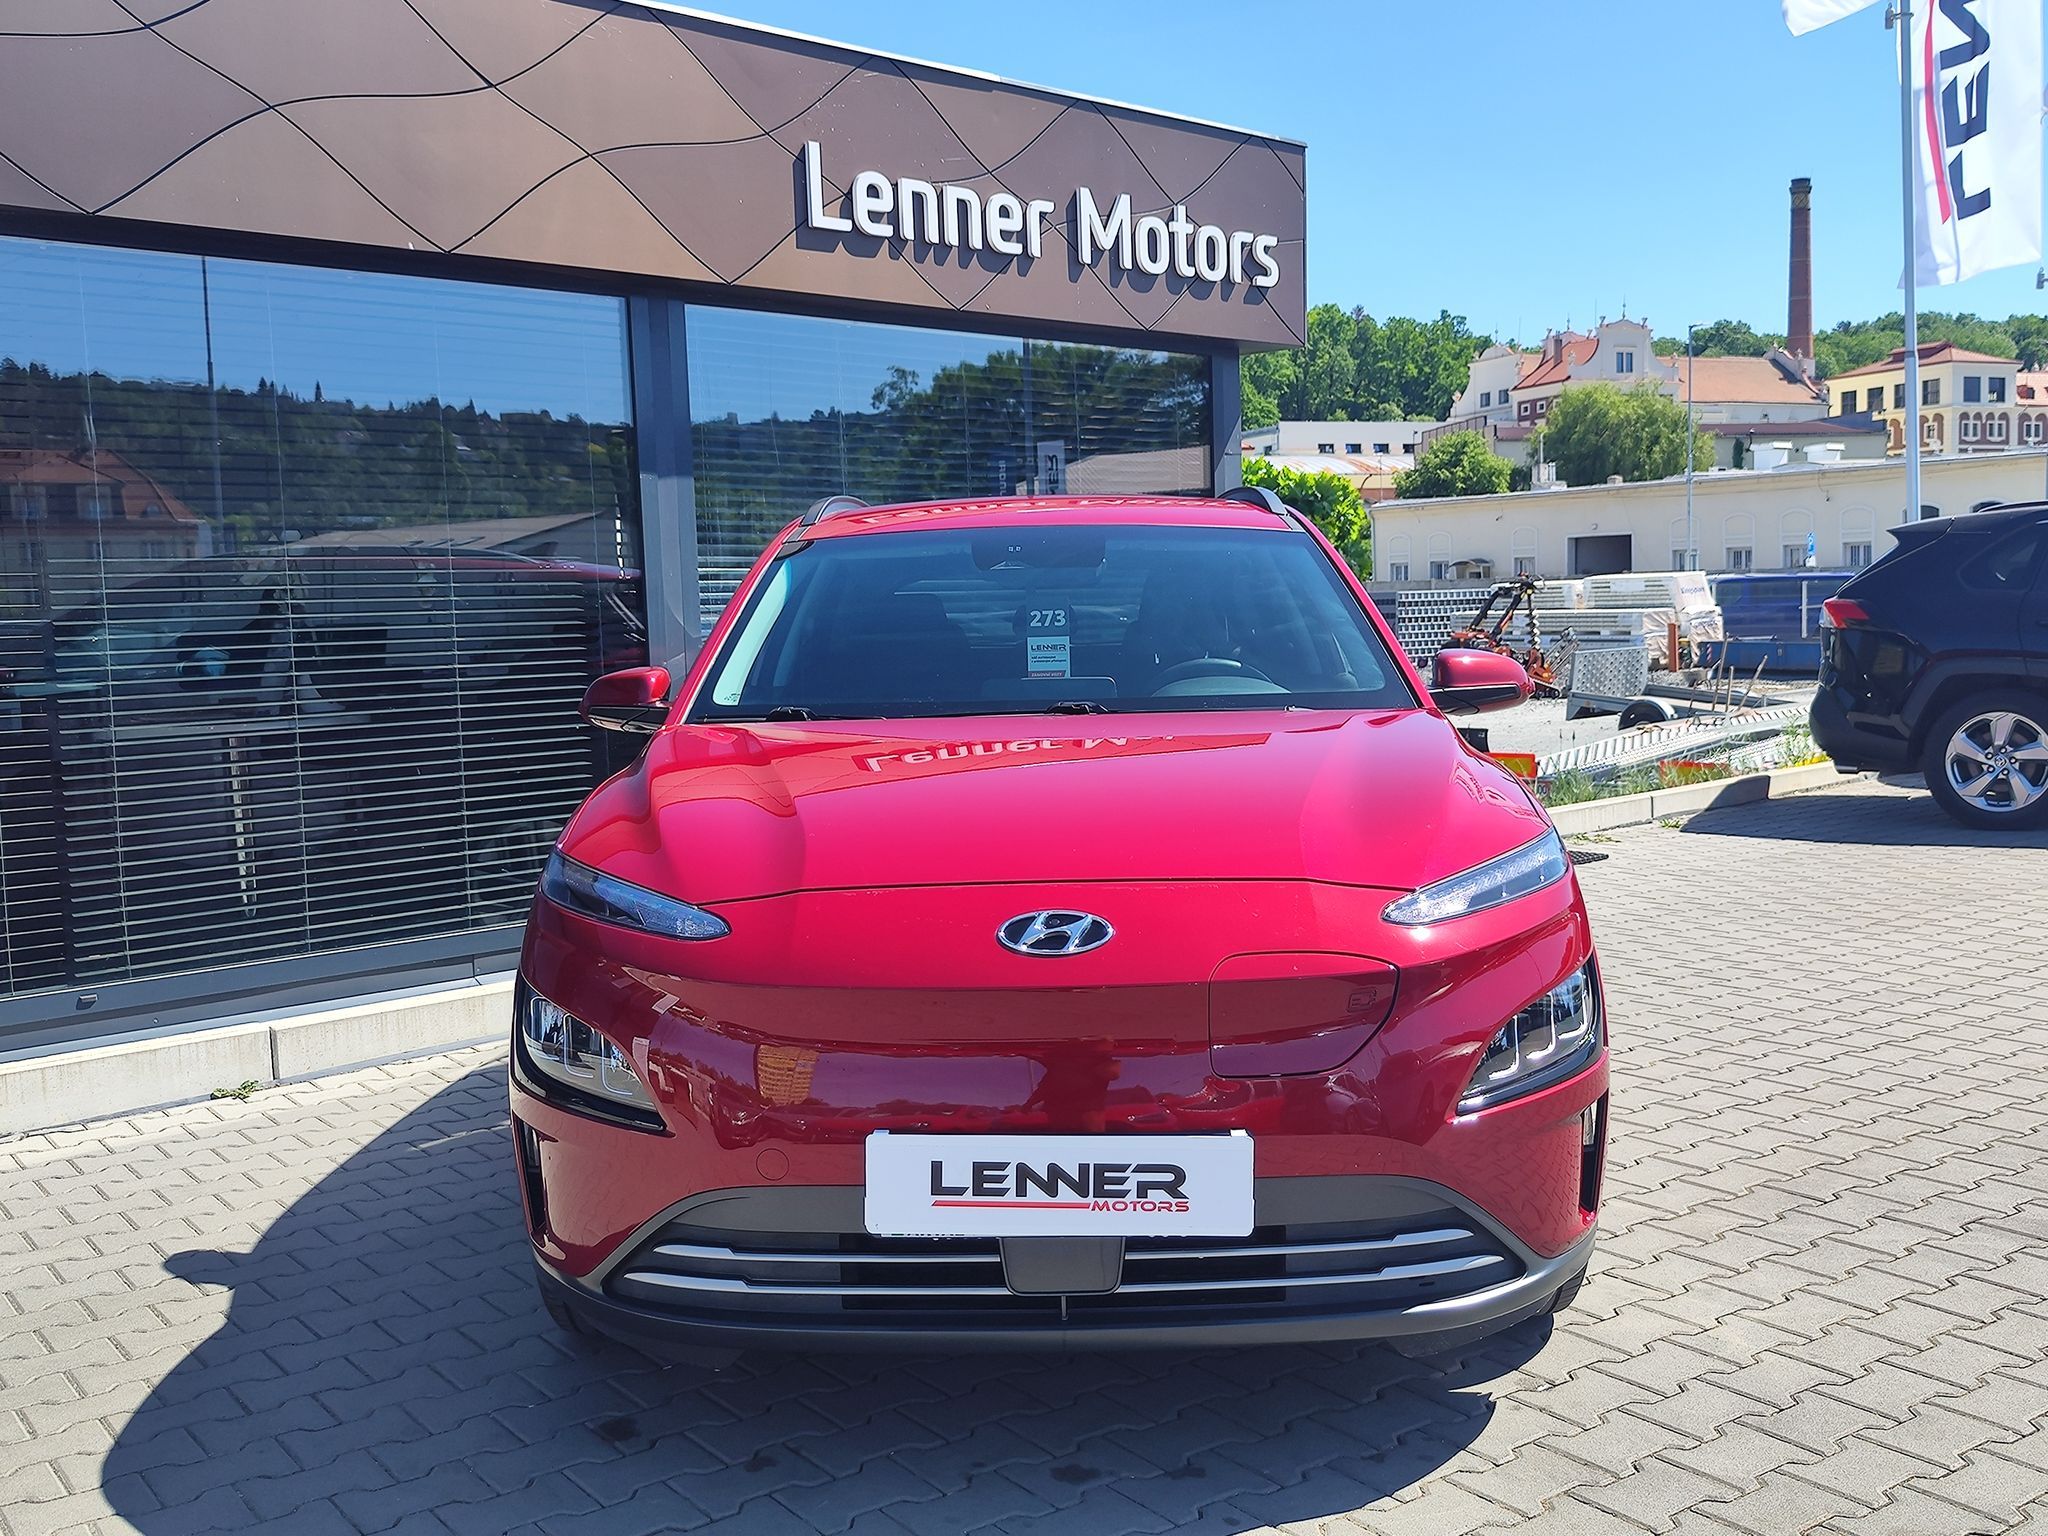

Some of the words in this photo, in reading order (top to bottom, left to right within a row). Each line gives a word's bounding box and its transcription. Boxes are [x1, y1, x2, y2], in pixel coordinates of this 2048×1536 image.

[805, 141, 1056, 259] Lenner
[1075, 186, 1280, 289] Motors
[1030, 609, 1067, 627] 273
[930, 1161, 1189, 1199] LENNER
[1091, 1200, 1190, 1213] MOTORS
